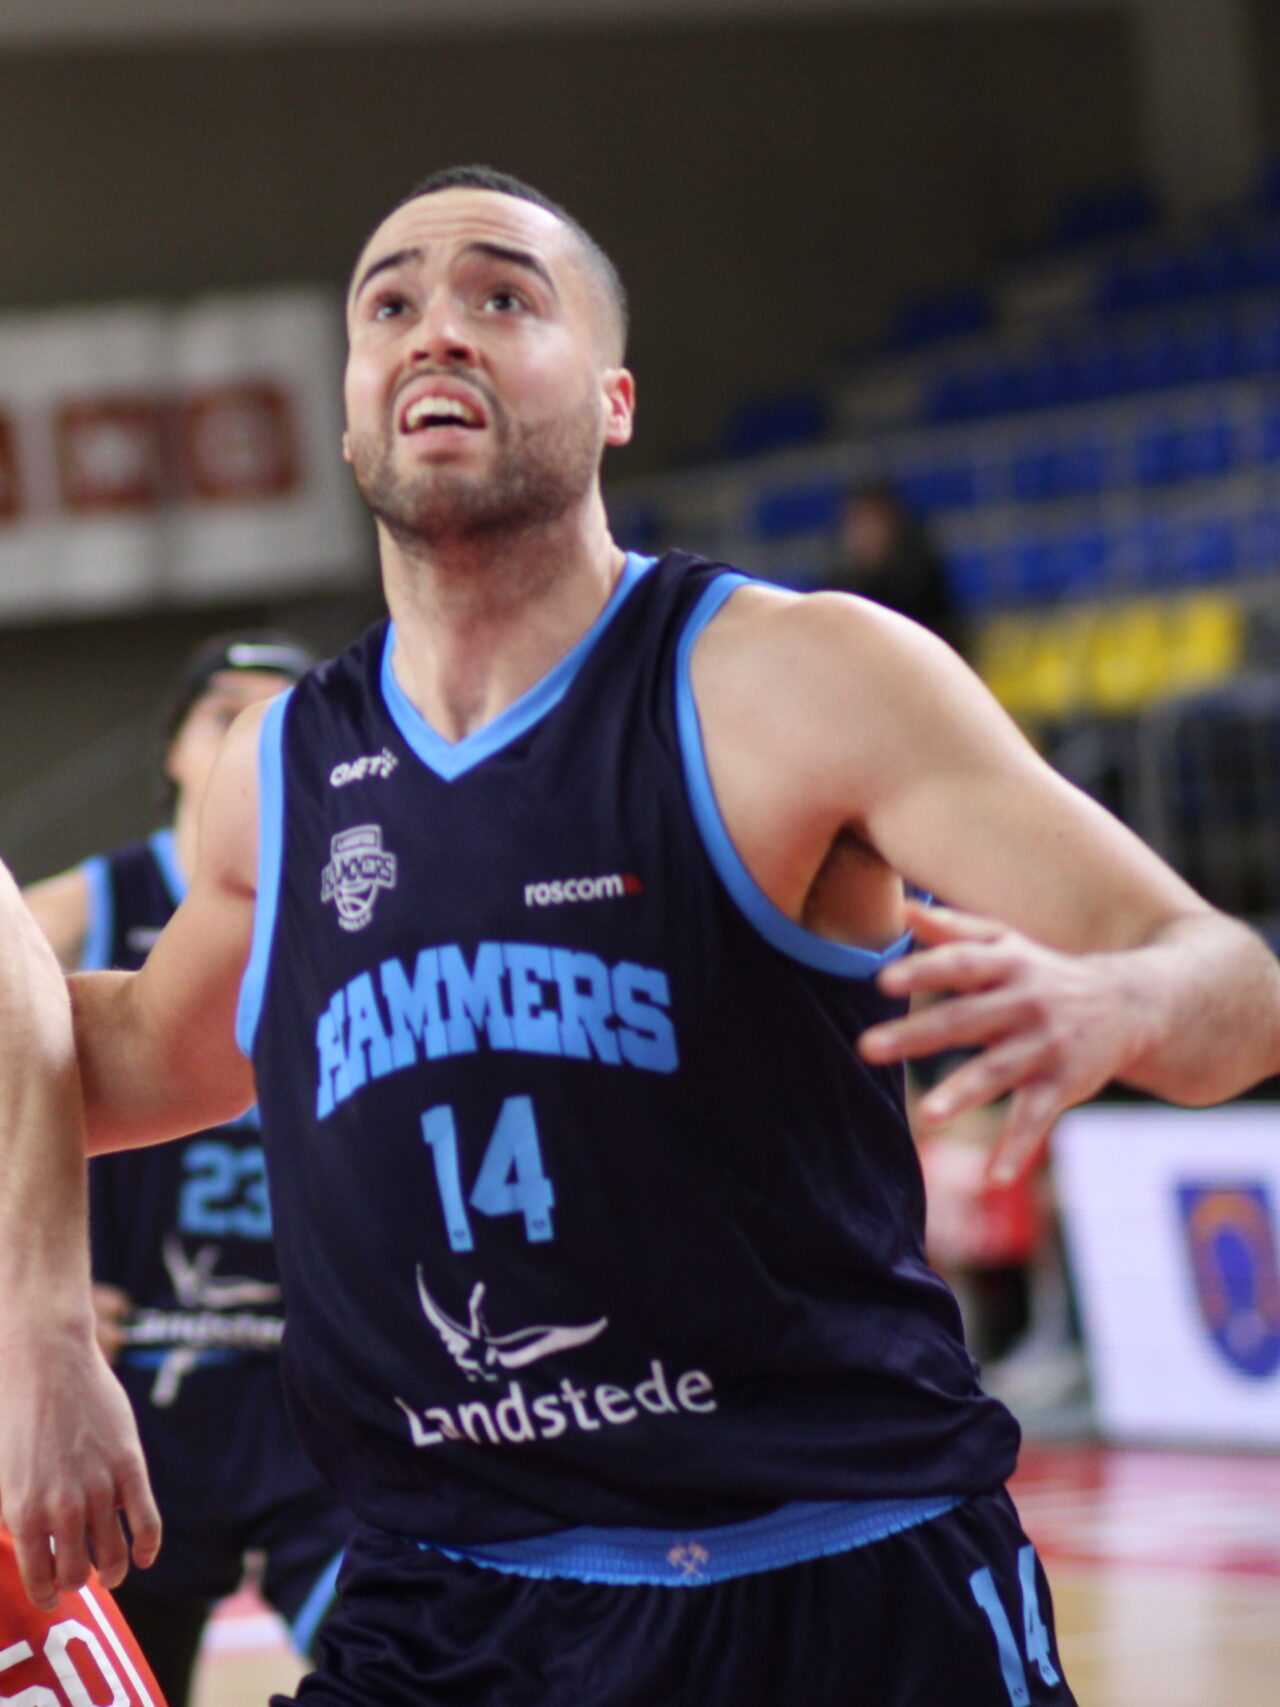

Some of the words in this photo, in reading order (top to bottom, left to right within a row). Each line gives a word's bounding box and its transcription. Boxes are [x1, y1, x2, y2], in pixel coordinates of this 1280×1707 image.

[525, 874, 623, 906] roscom
[317, 942, 679, 1121] HAMMERS
[179, 1140, 273, 1238] 23
[421, 1095, 555, 1252] 14
[394, 1359, 717, 1446] Landstede
[969, 1543, 1061, 1707] 14
